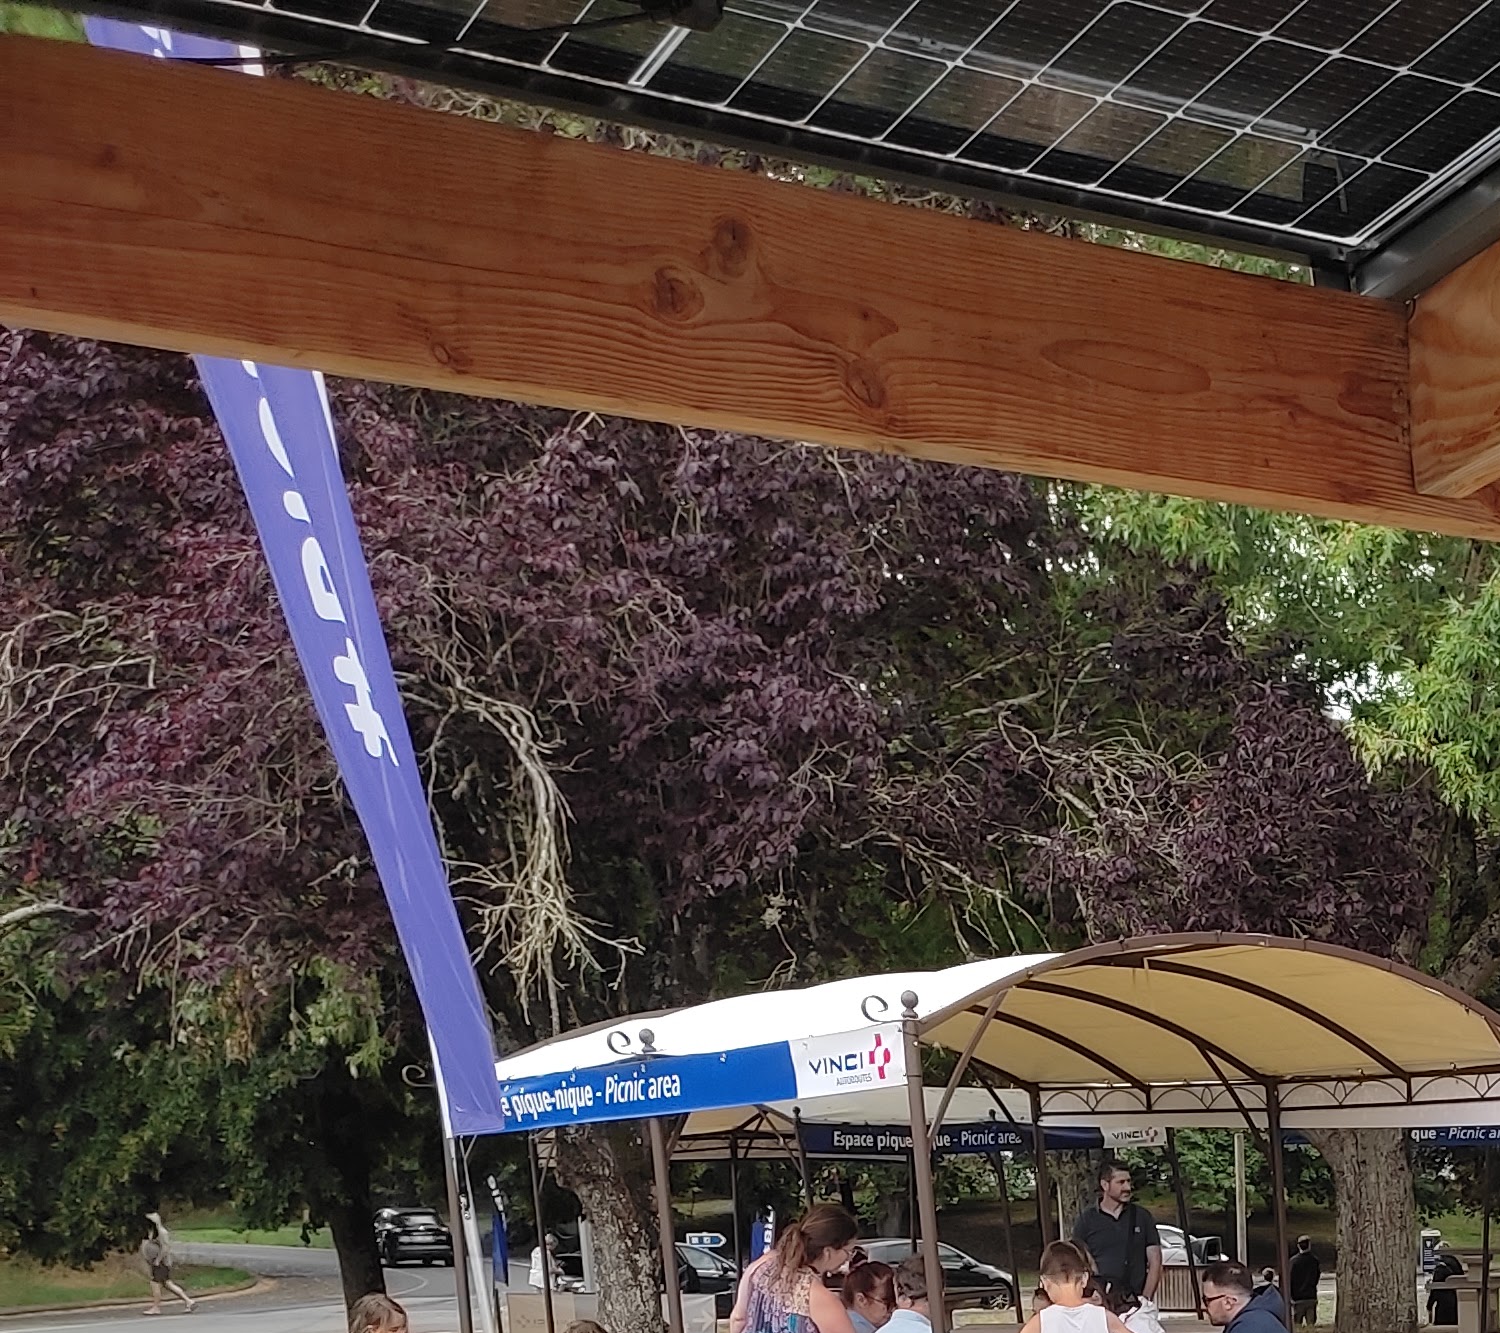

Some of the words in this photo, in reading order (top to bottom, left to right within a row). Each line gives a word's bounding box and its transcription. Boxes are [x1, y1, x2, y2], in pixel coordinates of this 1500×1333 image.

[808, 1052, 864, 1075] VINCI
[511, 1080, 594, 1123] pique-nique
[605, 1072, 647, 1104] Picnic
[648, 1073, 681, 1099] area
[833, 1130, 874, 1151] Espace
[961, 1130, 996, 1146] Picnic
[1112, 1130, 1143, 1140] VINCI
[1448, 1127, 1487, 1140] Picnic
